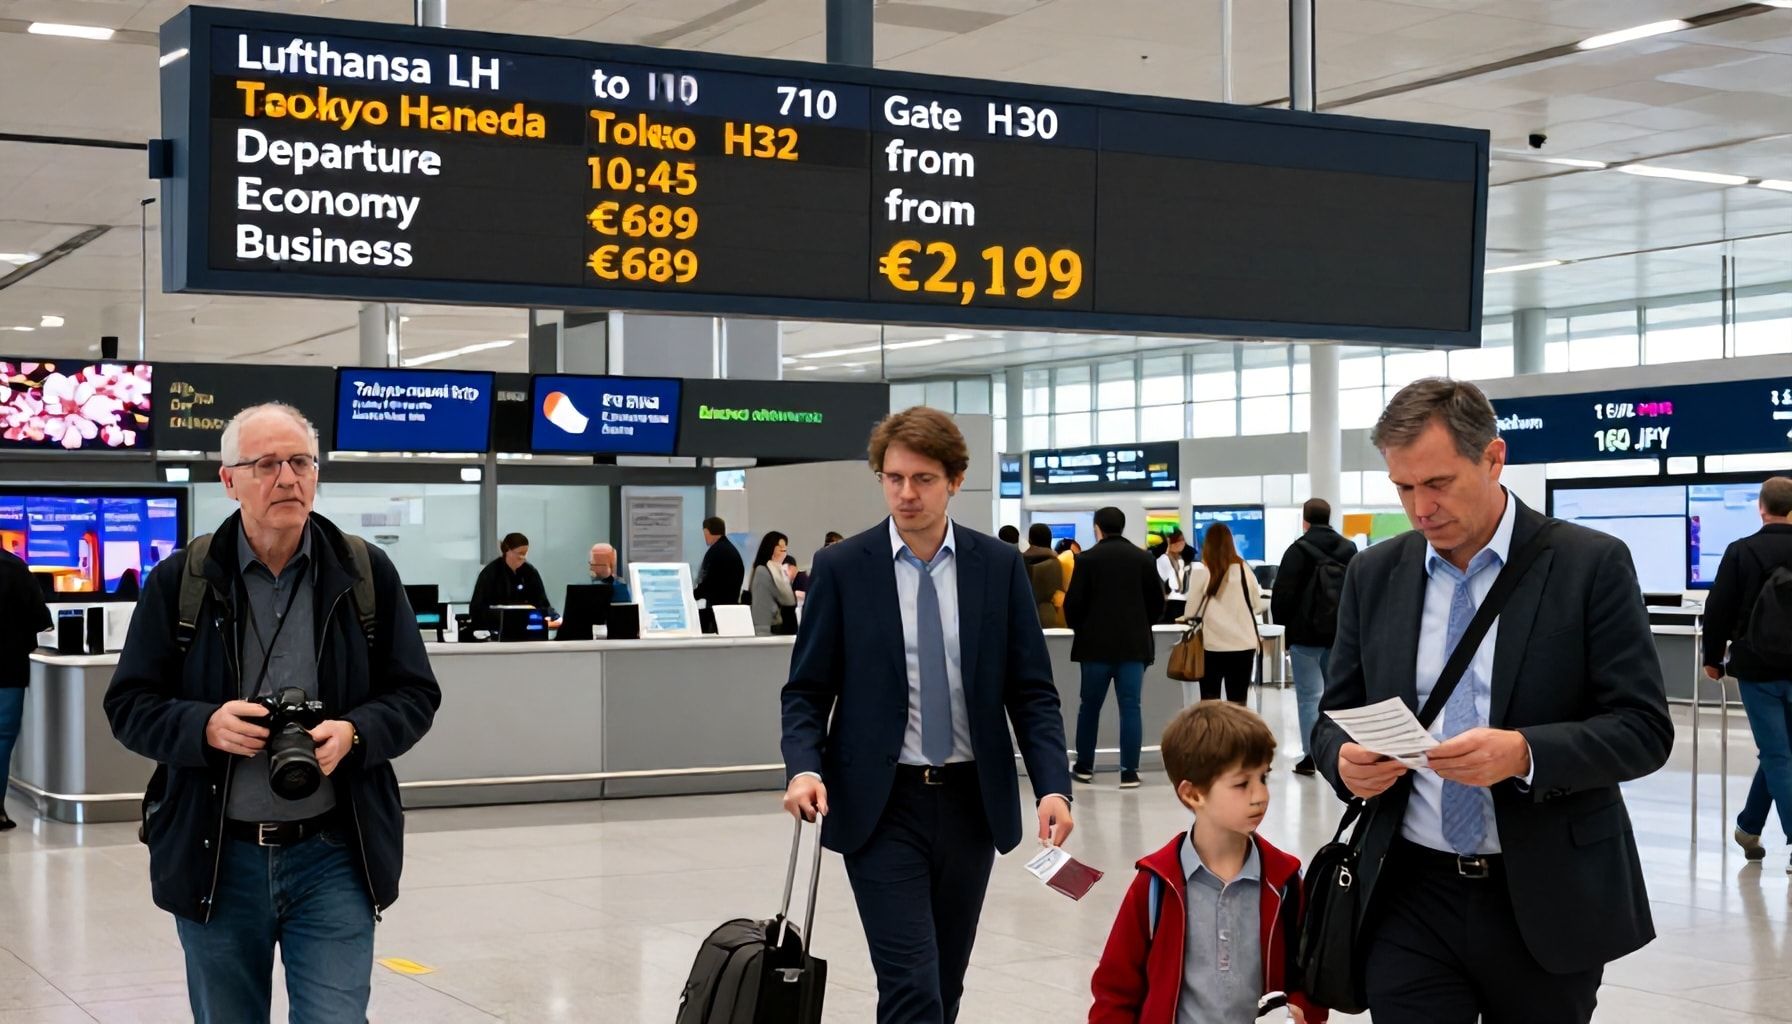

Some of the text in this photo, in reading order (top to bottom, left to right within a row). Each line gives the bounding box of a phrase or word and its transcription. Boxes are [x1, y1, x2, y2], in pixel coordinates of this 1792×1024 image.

[237, 34, 500, 91] Lufthansa LH
[592, 69, 630, 99] to
[777, 86, 837, 120] 710
[400, 95, 546, 139] Haneda
[884, 95, 1058, 140] Gate H30
[236, 128, 442, 177] Departure
[725, 122, 799, 161] H32
[885, 139, 975, 178] from
[587, 157, 698, 196] 10:45
[236, 176, 421, 230] Economy
[586, 201, 699, 240] €689
[885, 188, 975, 227] from
[236, 223, 414, 268] Business
[586, 244, 698, 283] €689
[879, 240, 1083, 305] €2,199
